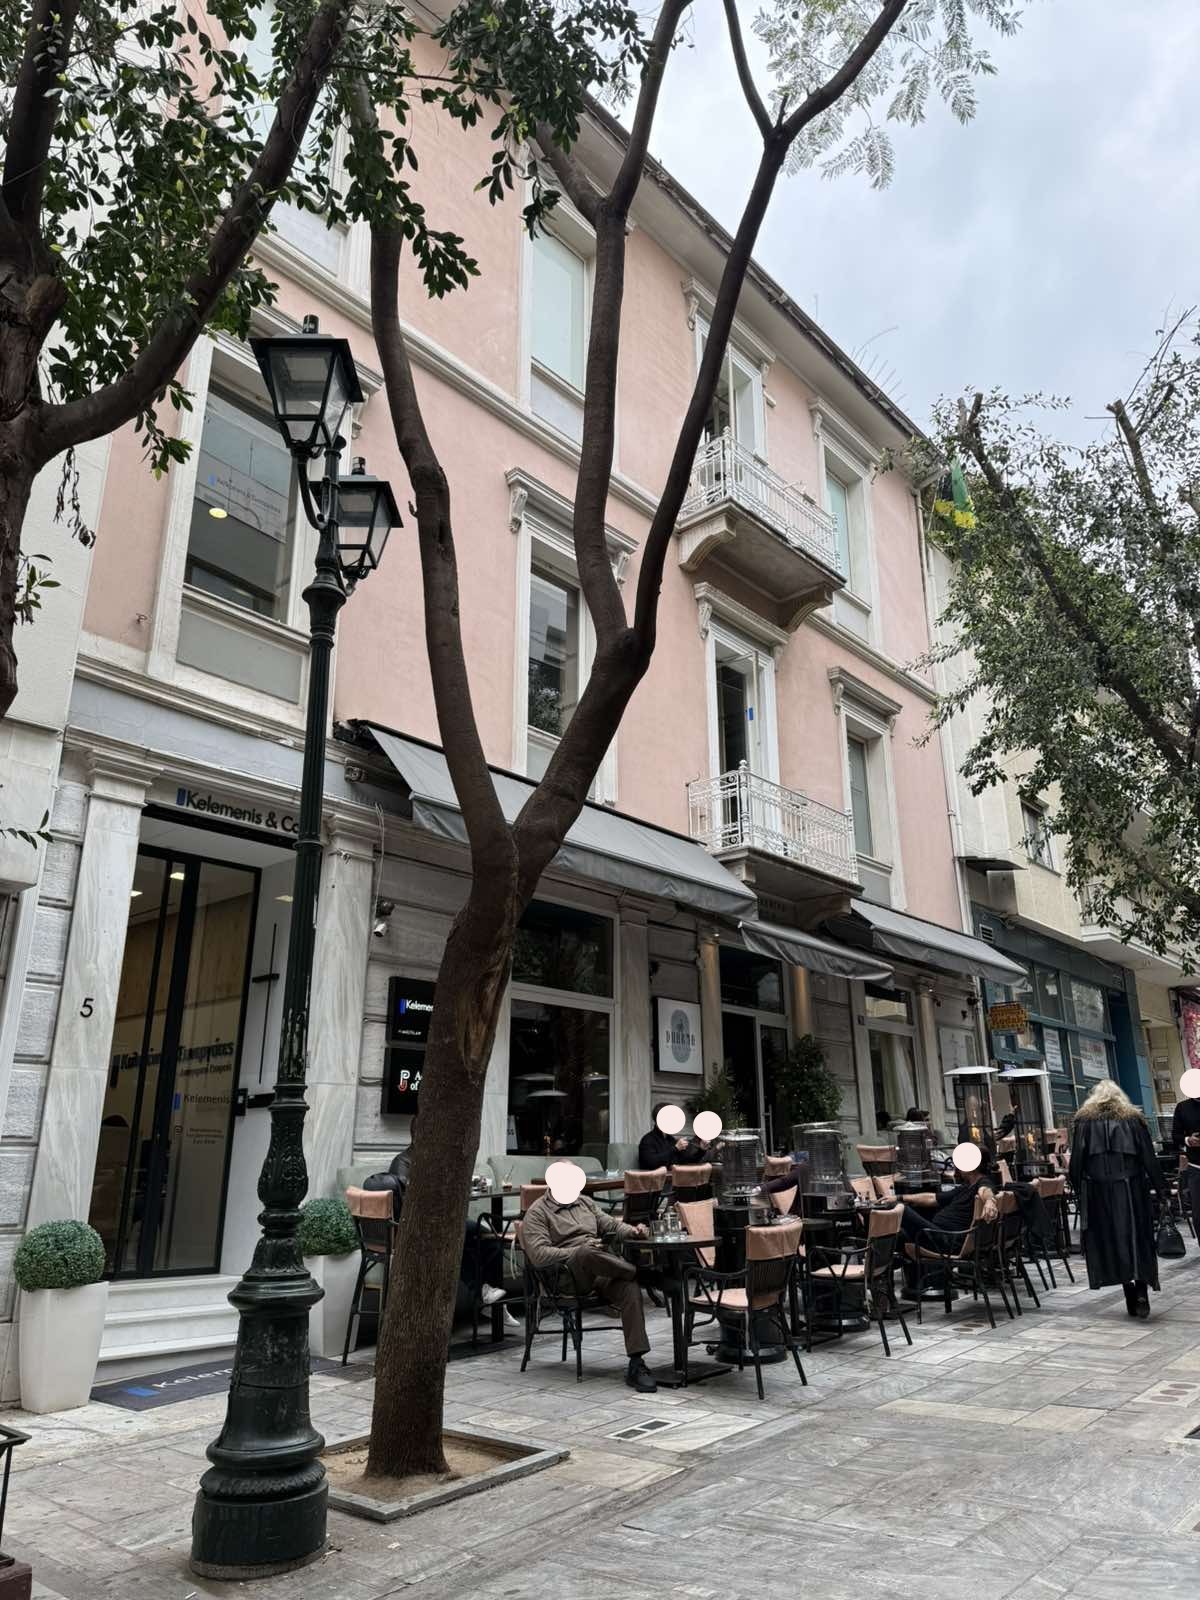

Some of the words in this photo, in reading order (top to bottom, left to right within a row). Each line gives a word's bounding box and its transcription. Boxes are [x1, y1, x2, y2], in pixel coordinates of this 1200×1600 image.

[186, 790, 263, 825] Kelemenis
[265, 810, 278, 829] &
[79, 997, 94, 1018] 5
